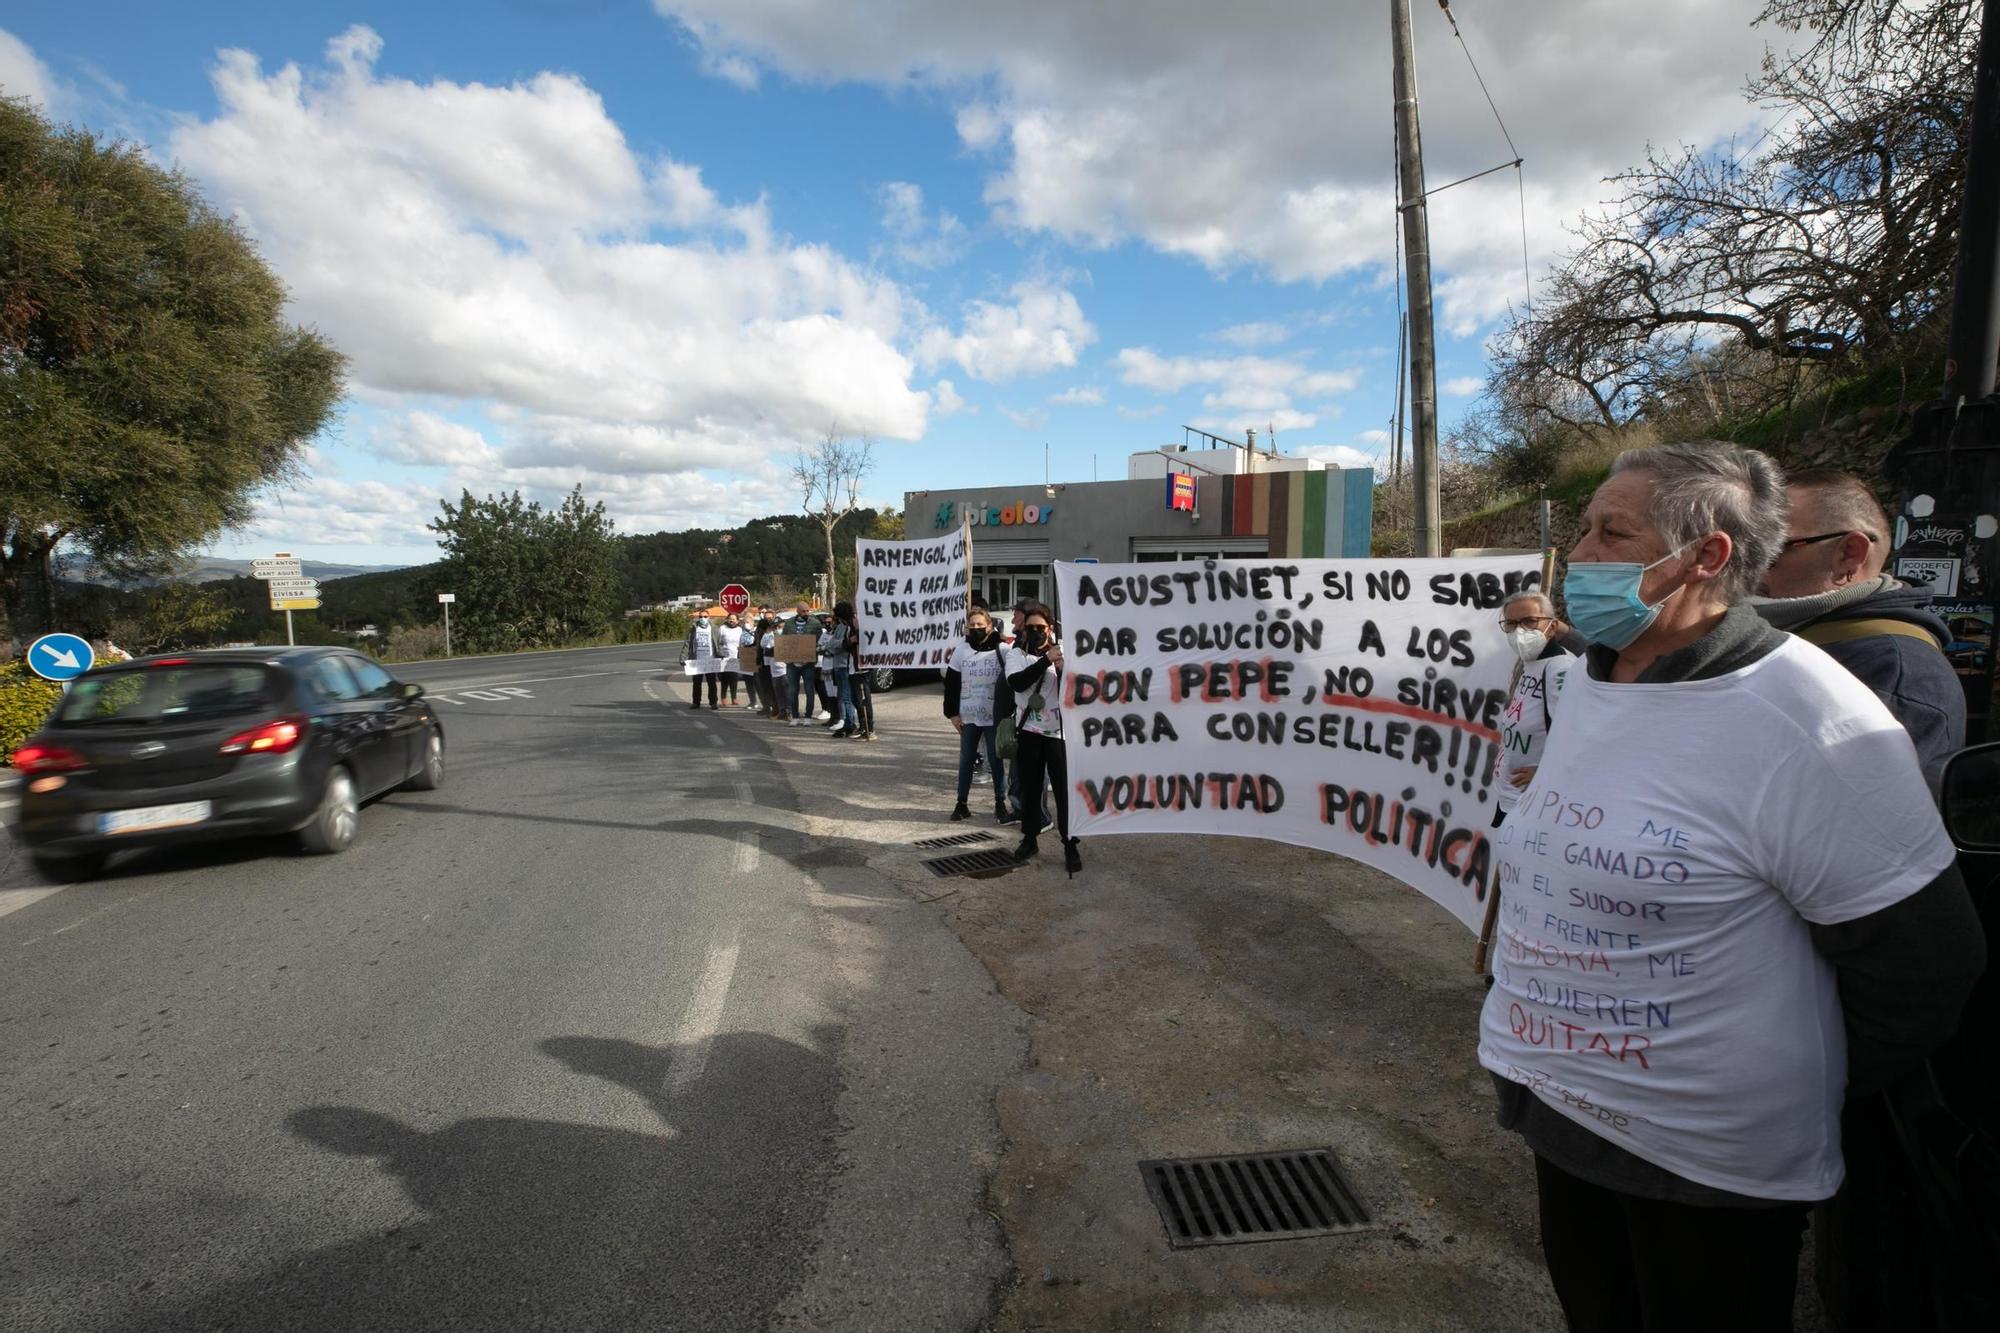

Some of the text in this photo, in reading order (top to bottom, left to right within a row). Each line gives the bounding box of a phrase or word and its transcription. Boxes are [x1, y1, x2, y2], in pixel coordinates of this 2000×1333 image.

[957, 500, 1053, 527] Ibicolor
[865, 577, 897, 596] QUE
[903, 578, 913, 594] A
[919, 575, 949, 594] RAFA
[1323, 570, 1353, 601] SI
[1365, 569, 1411, 602] NO
[721, 595, 749, 606] STOP
[864, 600, 883, 618] LE
[891, 601, 917, 618] DAS
[1923, 603, 1974, 617] ergolas
[864, 630, 874, 645] Y
[880, 630, 889, 645] A
[895, 623, 949, 645] NOSOTROS
[1075, 627, 1137, 657] DAR
[1358, 619, 1386, 657] A
[1406, 625, 1475, 667] LOS
[919, 650, 927, 665] A
[420, 687, 536, 705] TOP
[1067, 667, 1153, 706] DON
[1081, 711, 1178, 747] PARA
[1078, 772, 1285, 815] VOLUNTAD
[1638, 819, 1691, 850] ME
[1523, 831, 1549, 855] HE
[1564, 843, 1689, 883] GANADO
[1533, 874, 1553, 897] EL
[1569, 888, 1666, 921] SUDOR
[1648, 951, 1697, 979] ME
